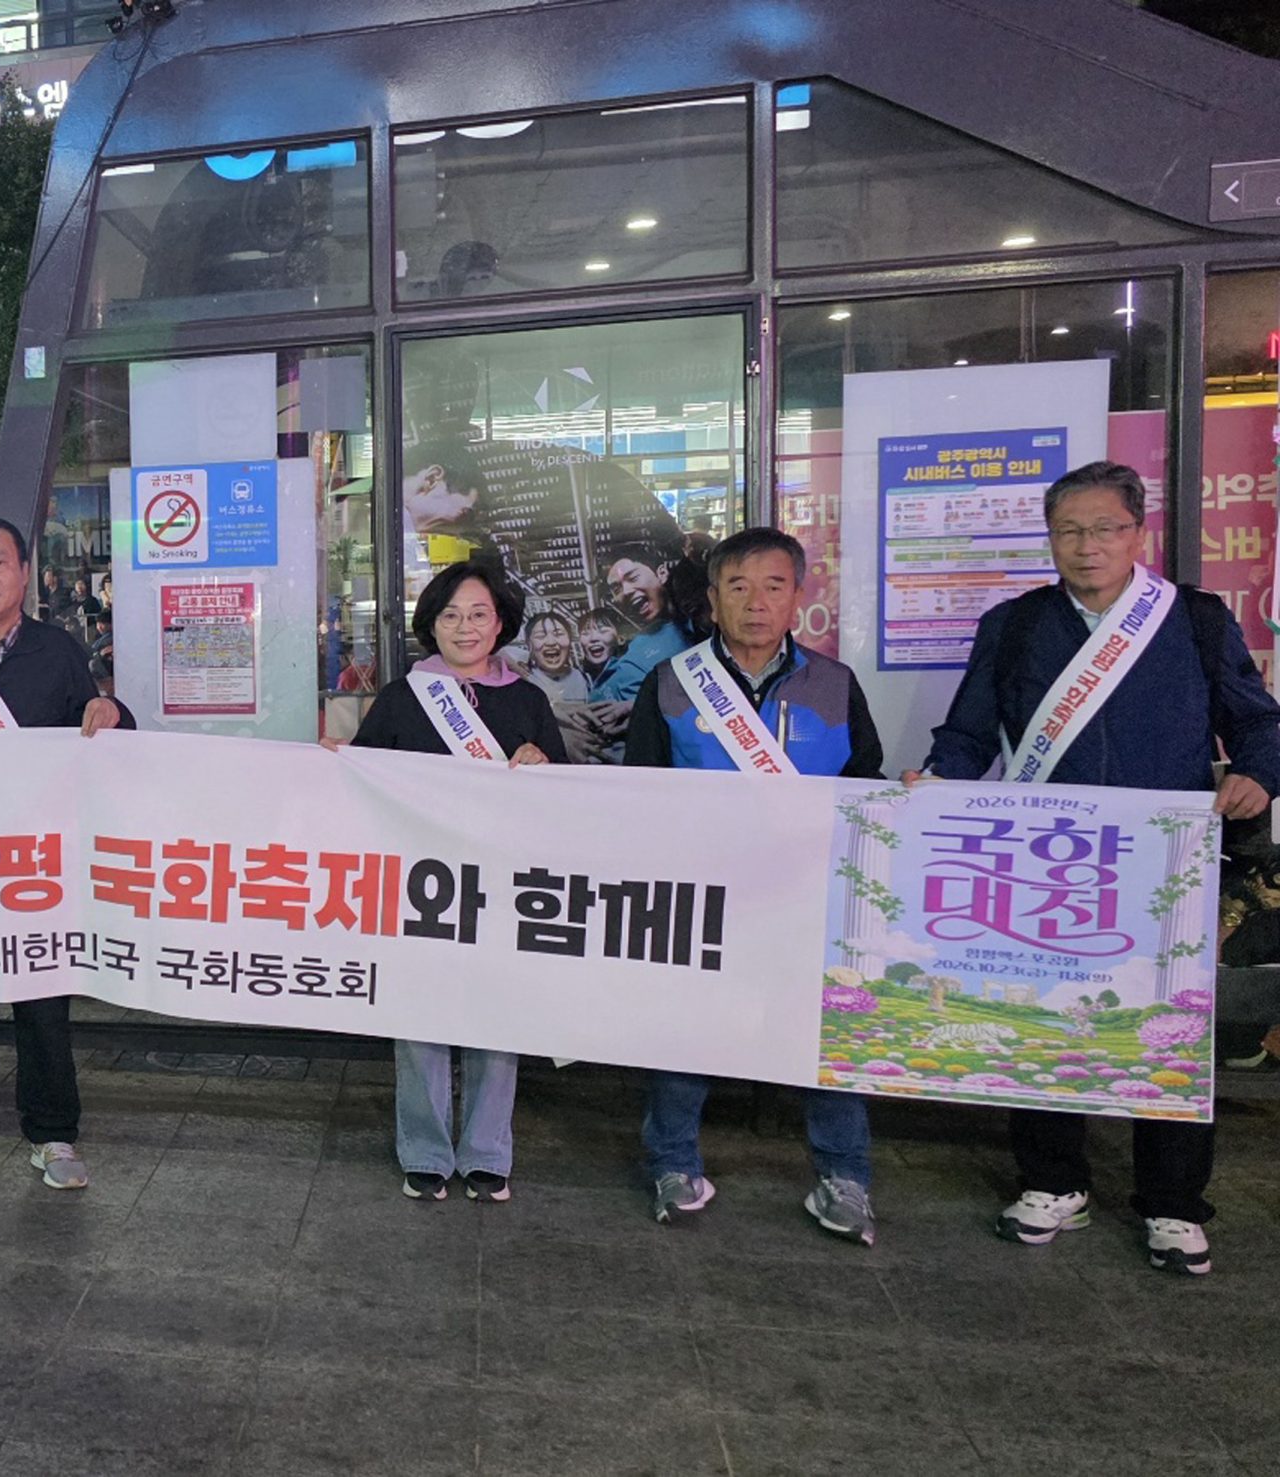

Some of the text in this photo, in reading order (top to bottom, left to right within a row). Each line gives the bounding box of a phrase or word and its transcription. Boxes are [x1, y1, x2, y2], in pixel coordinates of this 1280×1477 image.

[548, 455, 604, 465] DESCENTE
[903, 459, 1042, 481] 시내버스 이용 안내
[937, 446, 1007, 462] 광주광역시
[151, 473, 194, 487] 금연구역
[218, 505, 265, 515] 버스정류소
[148, 549, 198, 559] No Smoking
[1120, 585, 1161, 635] 가을은
[1094, 634, 1130, 673] 함평
[438, 696, 471, 740] 가을은
[694, 670, 733, 717] 가을은
[726, 715, 759, 751] 함평
[1032, 669, 1102, 756] 국화축제와
[965, 796, 1098, 815] 2026 대한민국
[921, 815, 1134, 887] 국향
[90, 836, 486, 944] 국화축제와
[513, 867, 726, 972] 함께!
[923, 876, 1135, 957] 대전
[156, 947, 378, 1005] 국화동호회
[966, 948, 1079, 967] 함평엑스포공원
